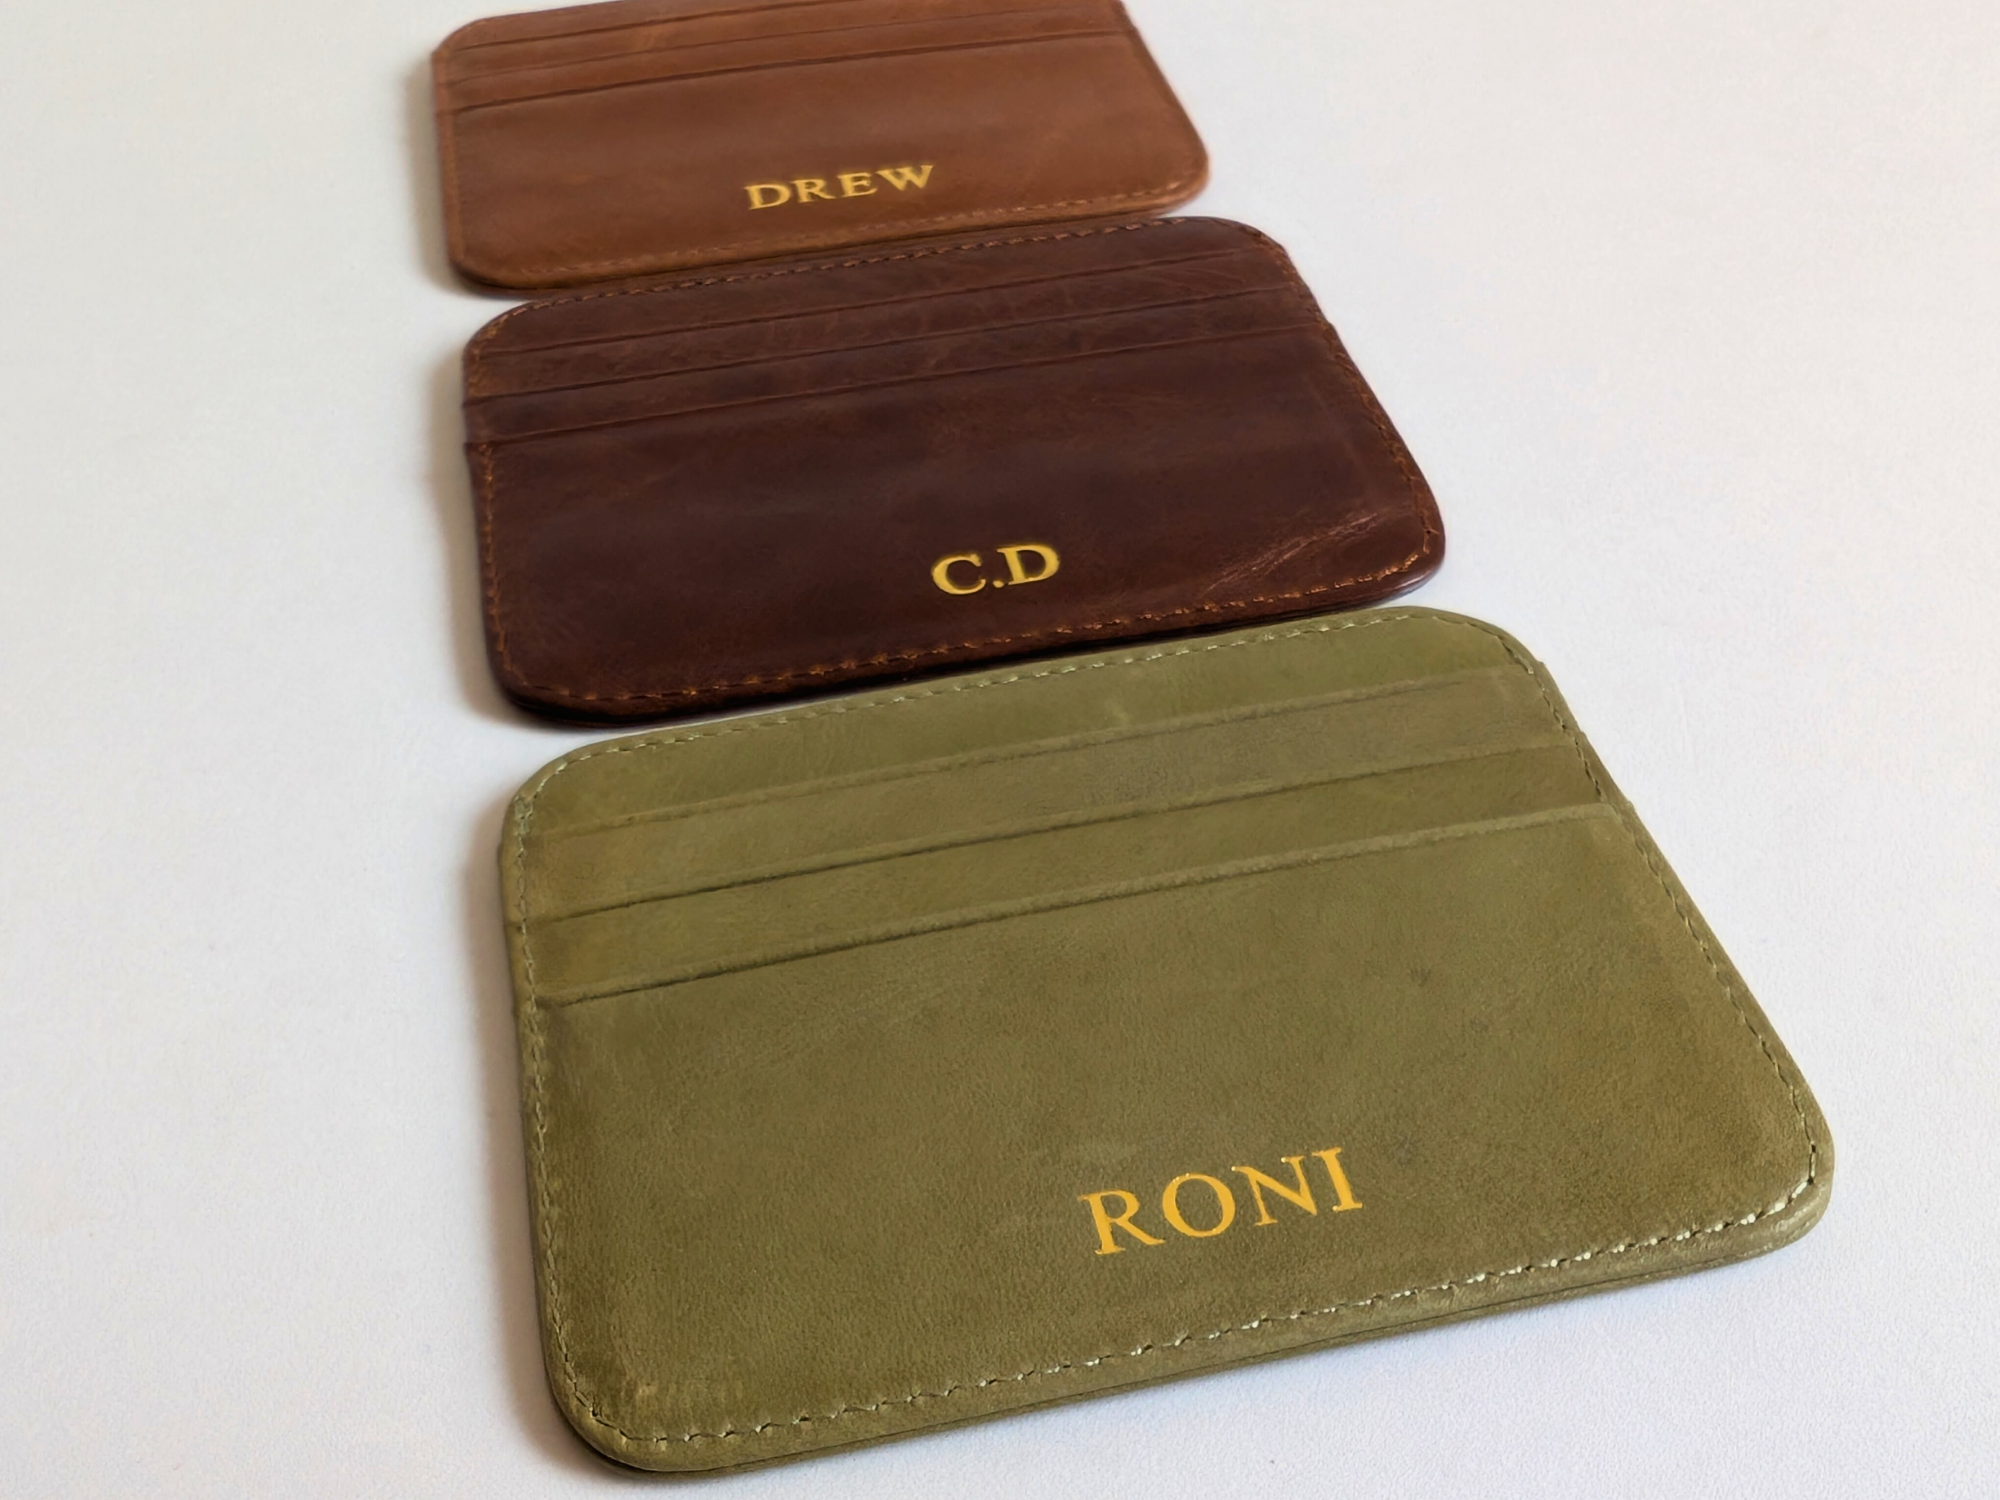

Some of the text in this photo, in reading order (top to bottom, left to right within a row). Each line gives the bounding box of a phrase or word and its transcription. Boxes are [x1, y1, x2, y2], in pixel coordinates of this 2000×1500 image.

[744, 163, 935, 210] DREW
[931, 543, 1060, 596] C.D
[1080, 1146, 1365, 1256] RONI
